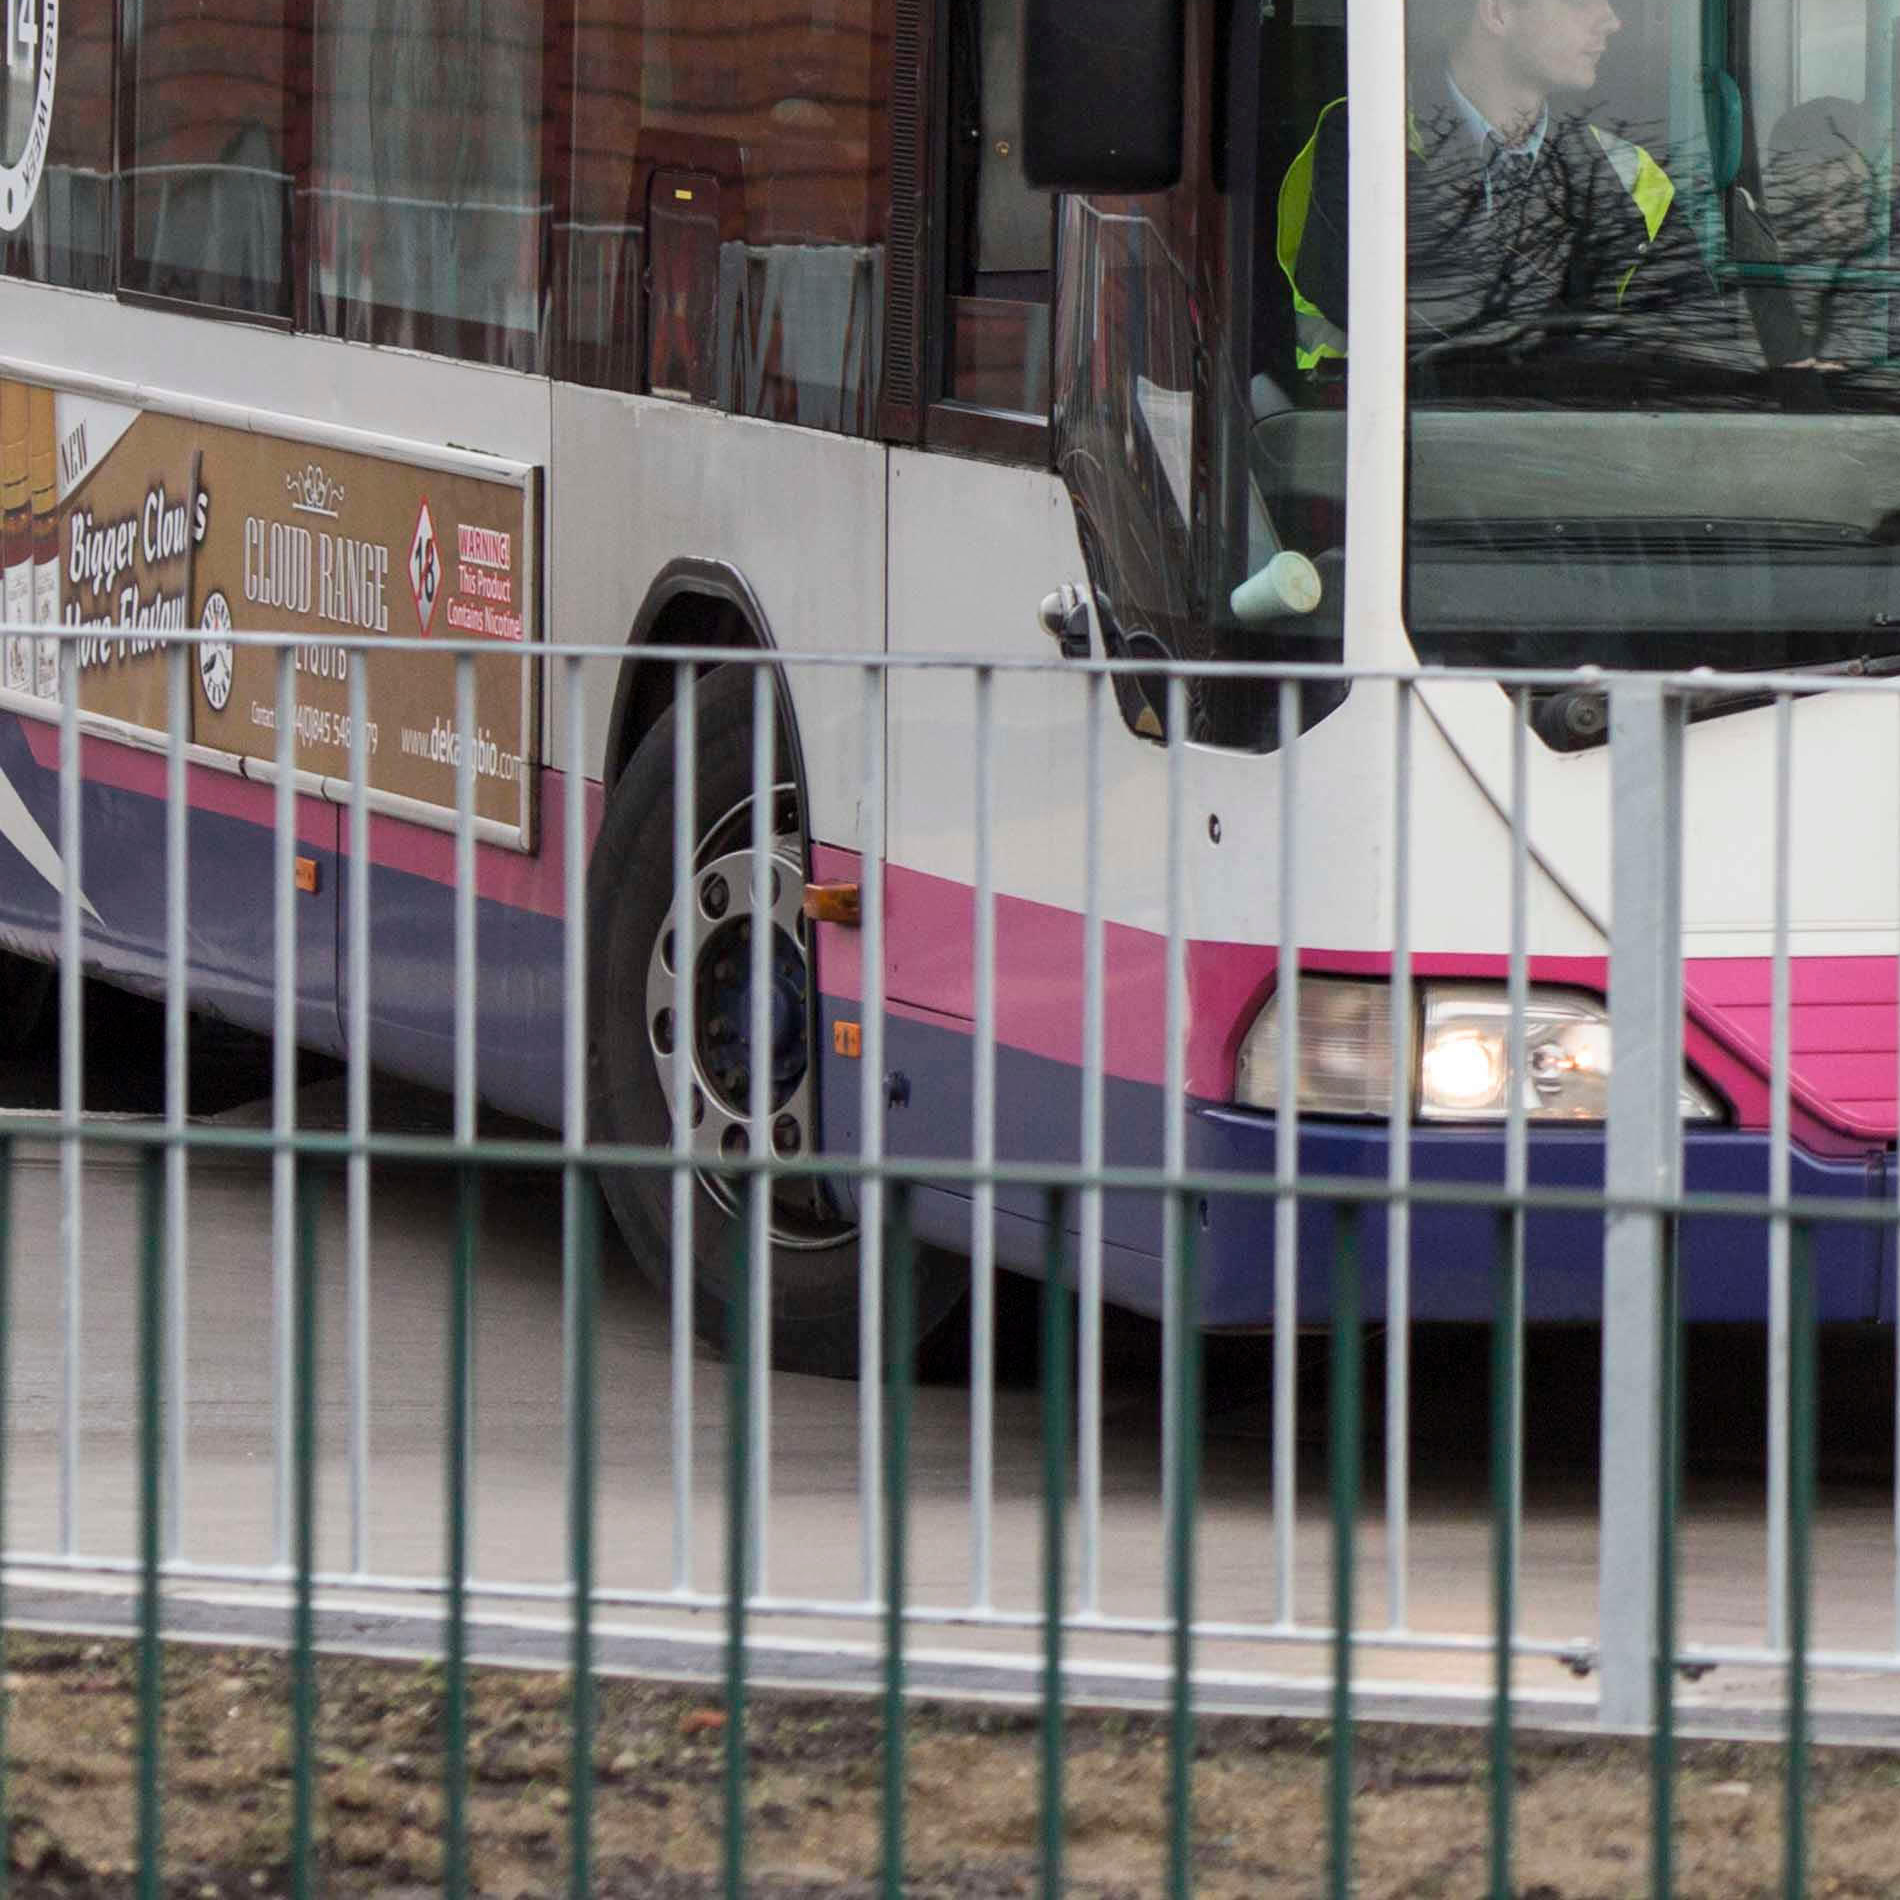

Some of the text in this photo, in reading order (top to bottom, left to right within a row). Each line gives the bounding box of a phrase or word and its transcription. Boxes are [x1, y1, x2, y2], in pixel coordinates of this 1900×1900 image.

[60, 419, 88, 484] NEW
[69, 486, 208, 596] Bigger Clous
[458, 524, 512, 570] WARNING!
[243, 516, 389, 633] CLOUD RANGE
[458, 564, 511, 603] This Product
[447, 597, 483, 631] Contains
